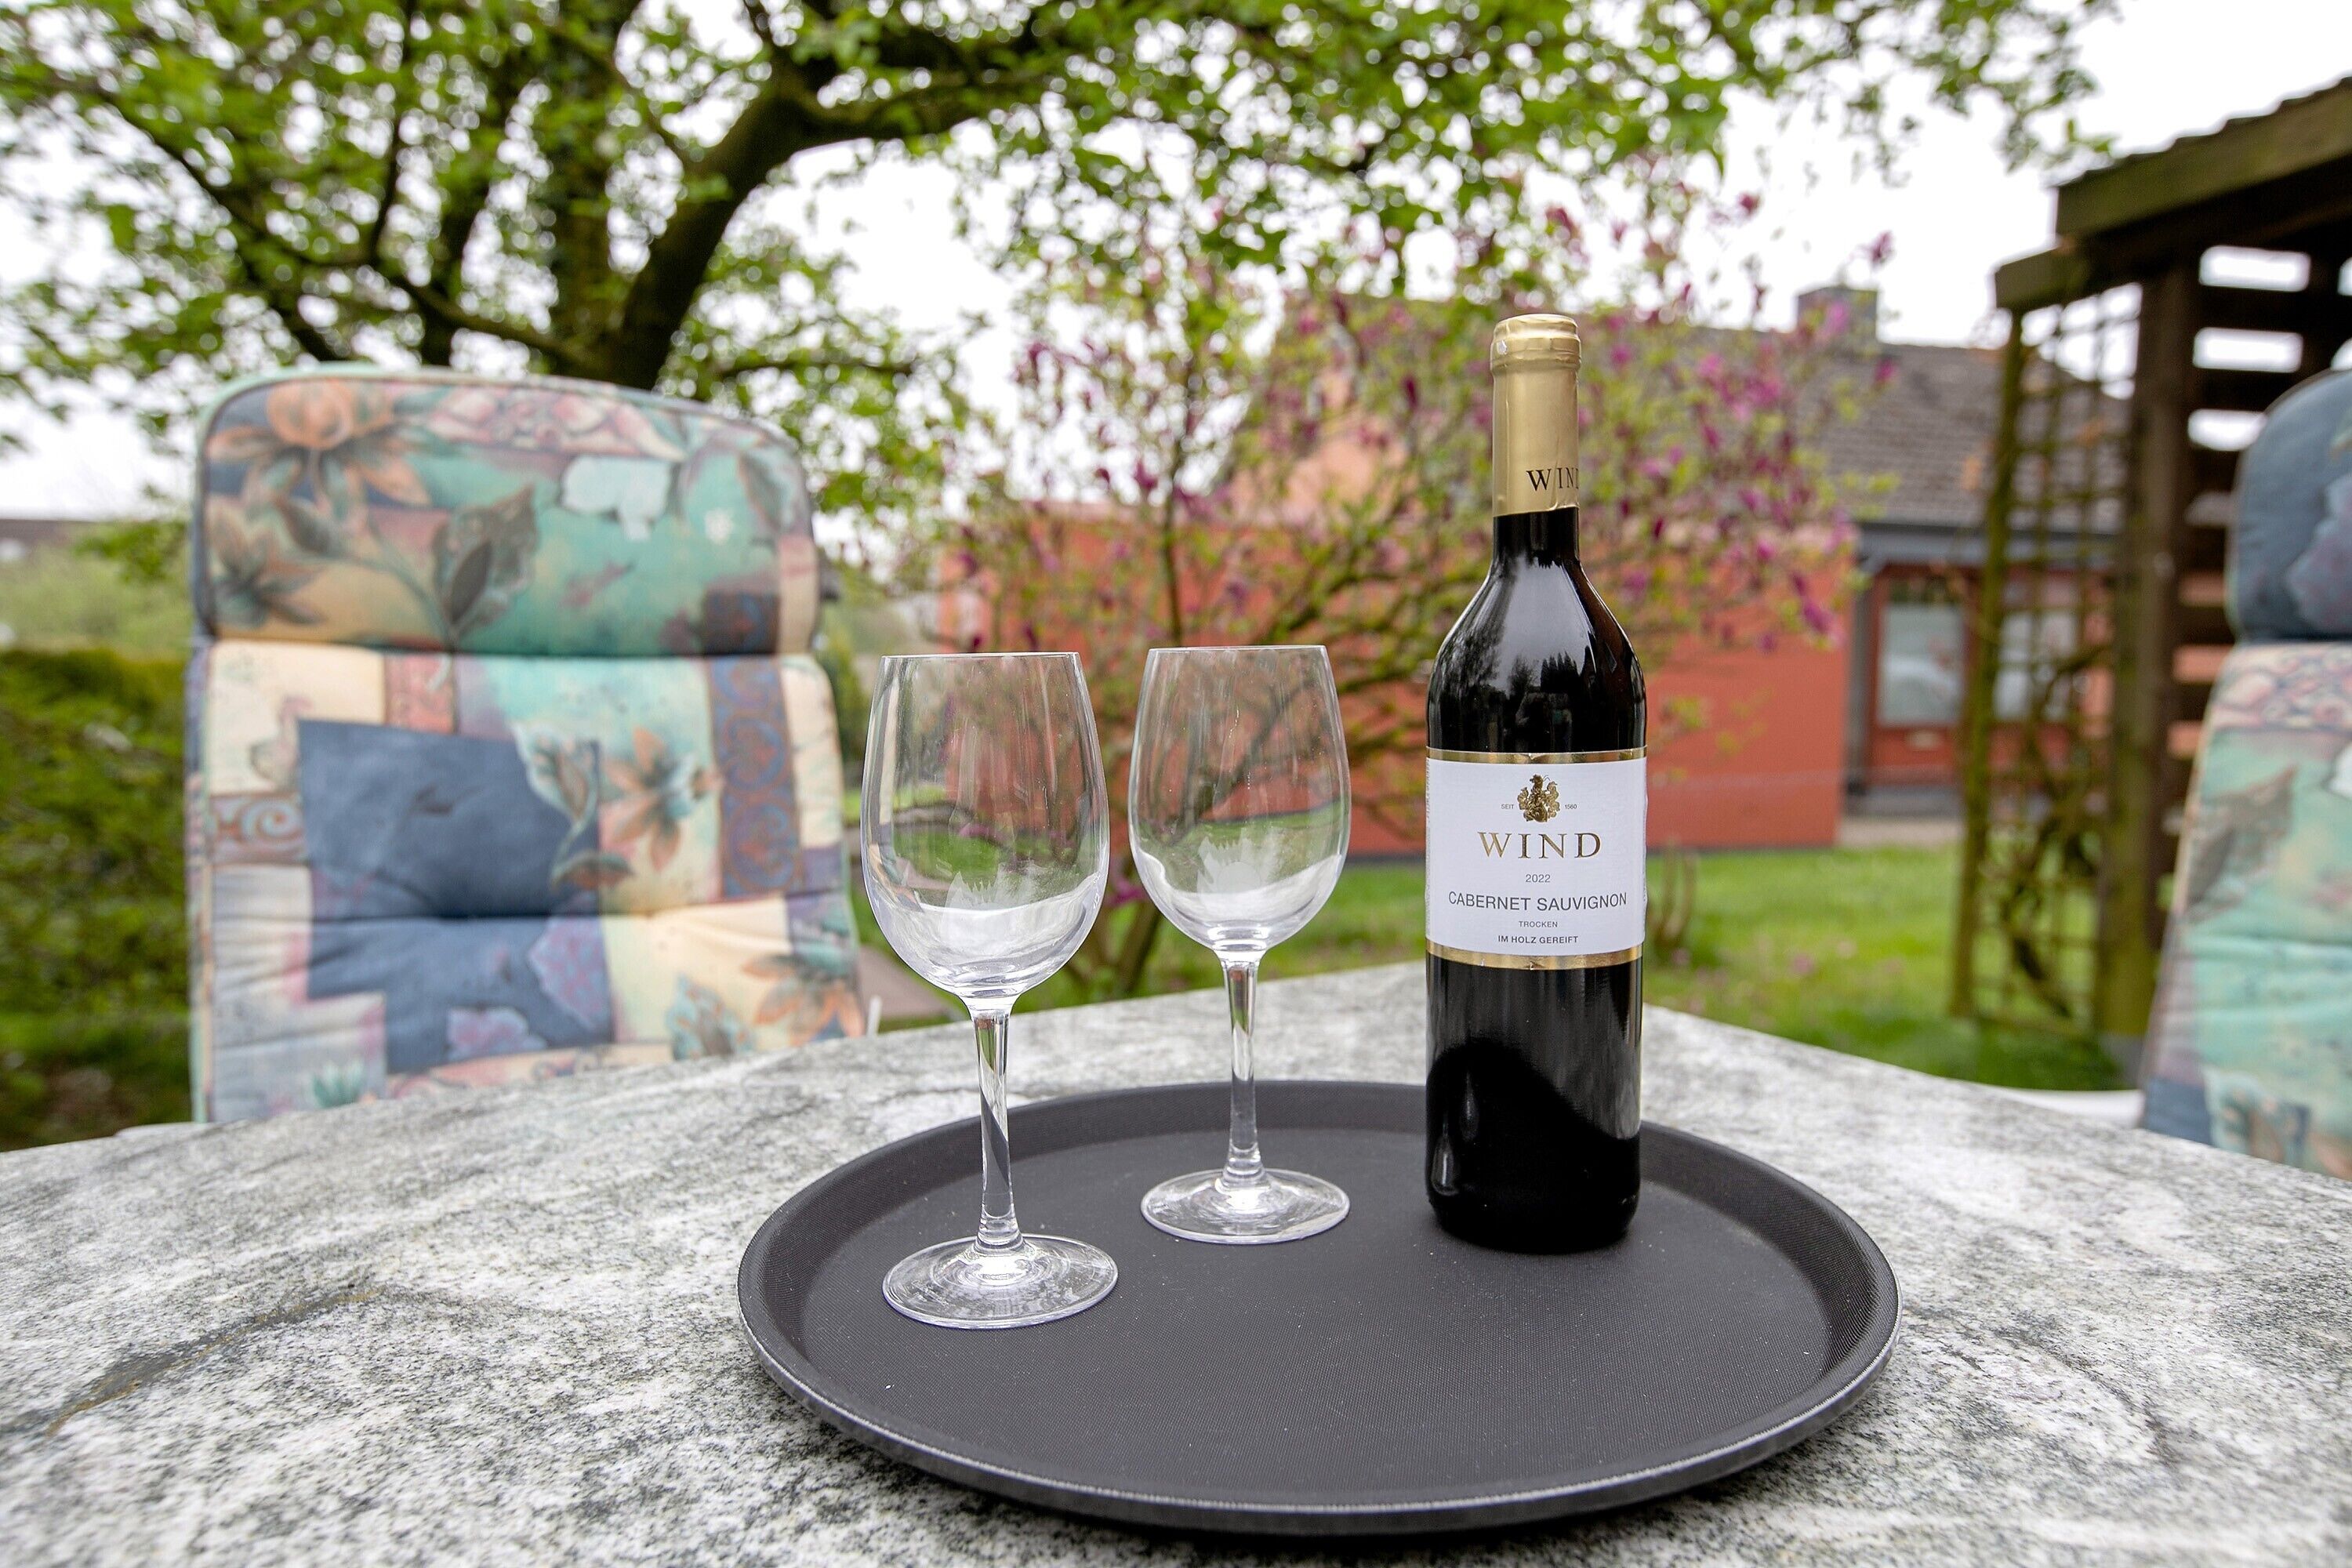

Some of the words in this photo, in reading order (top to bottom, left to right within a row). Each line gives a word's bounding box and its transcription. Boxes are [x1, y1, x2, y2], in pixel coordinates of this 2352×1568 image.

[1477, 832, 1601, 859] WIND
[1526, 874, 1551, 883] 2022
[1449, 891, 1531, 911] CABERNET
[1537, 892, 1627, 911] SAUVIGNON
[1539, 935, 1578, 944] GEREIFT
